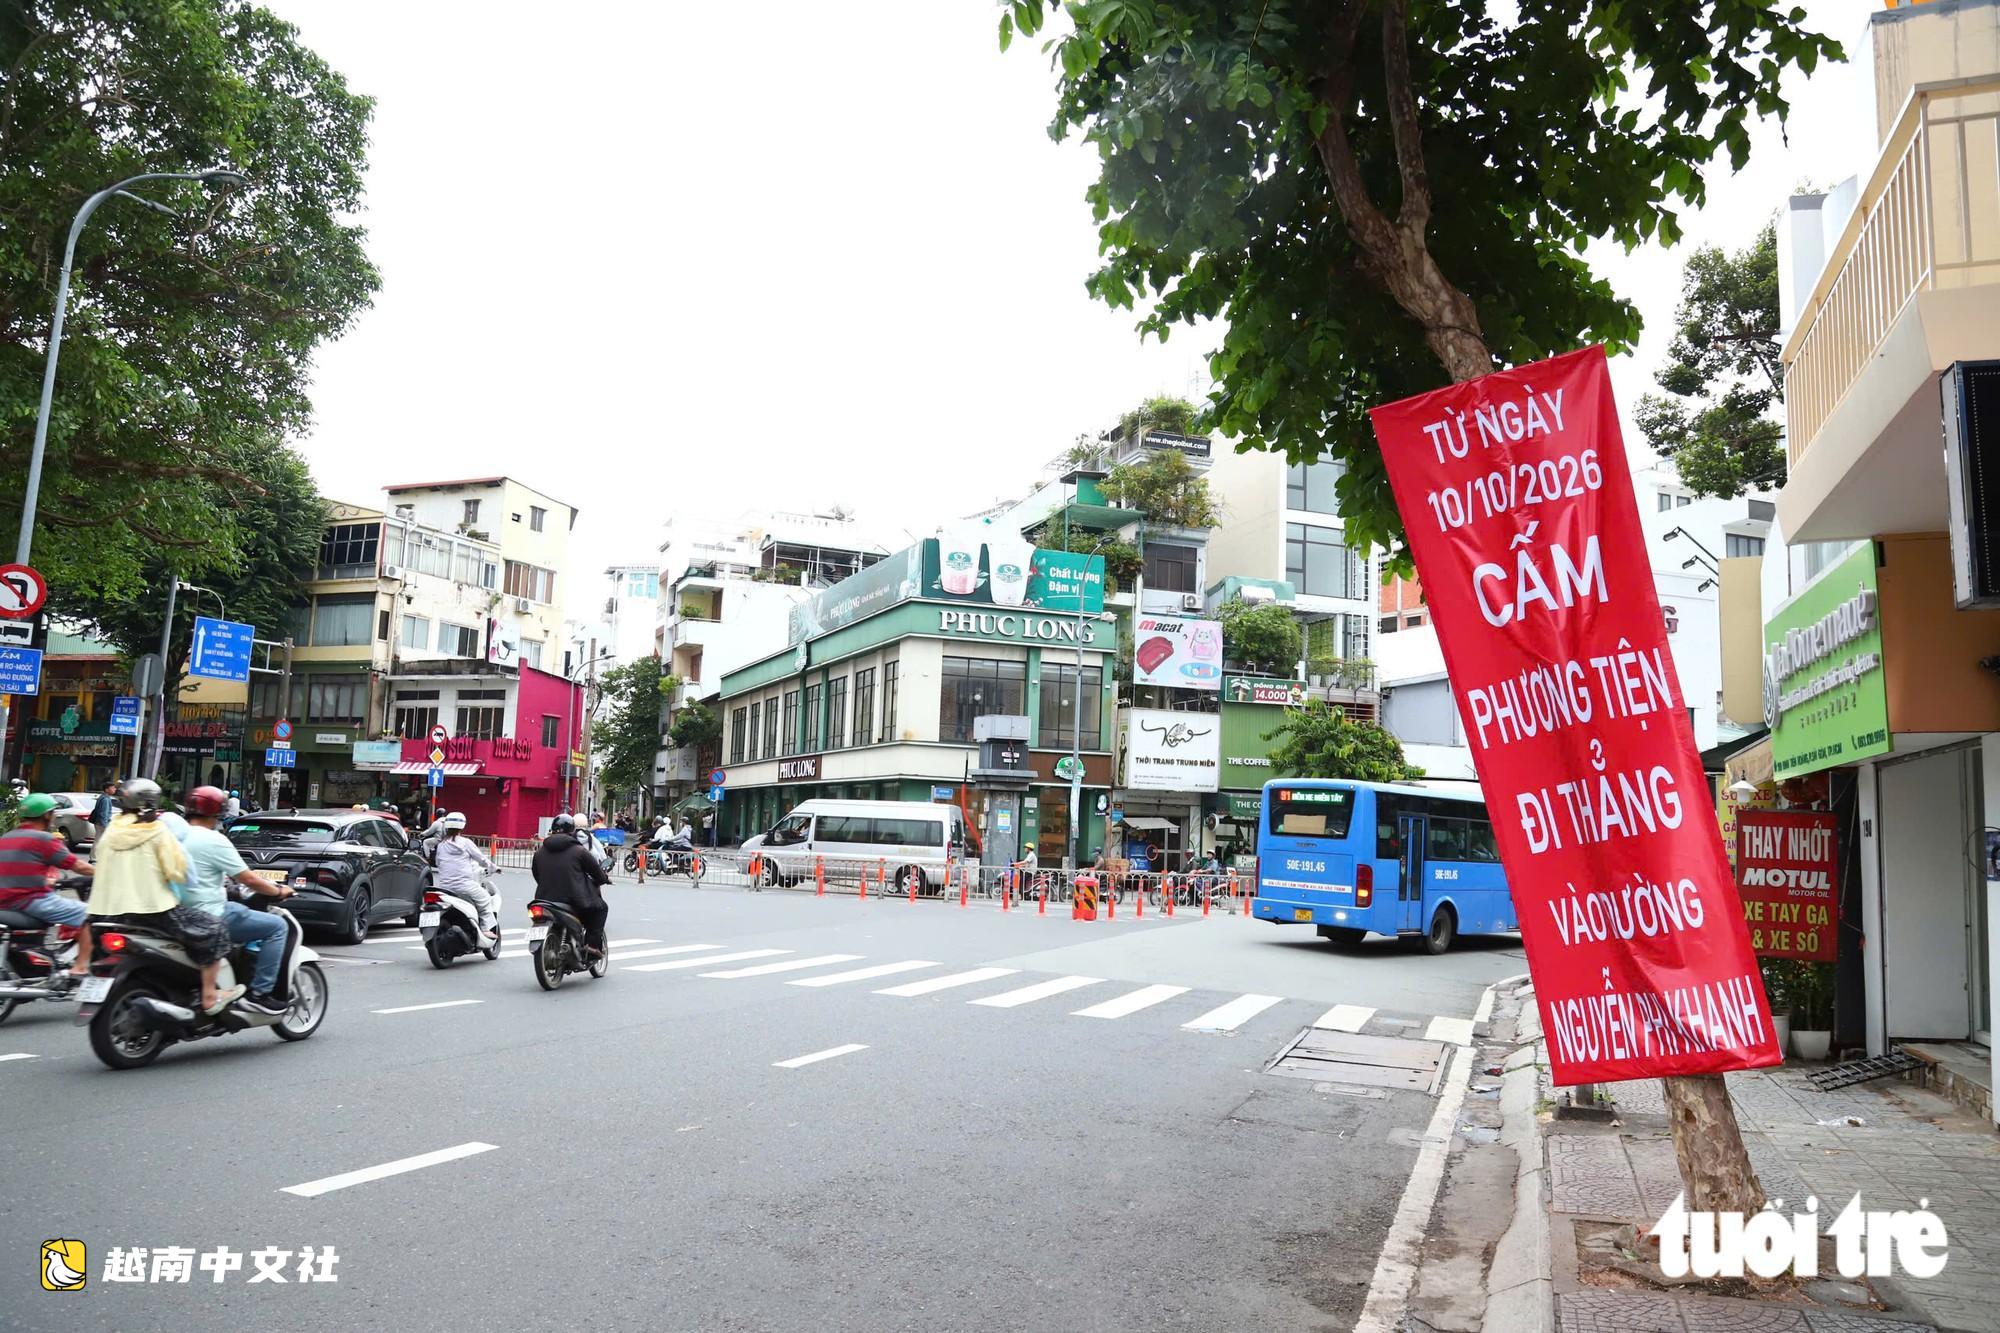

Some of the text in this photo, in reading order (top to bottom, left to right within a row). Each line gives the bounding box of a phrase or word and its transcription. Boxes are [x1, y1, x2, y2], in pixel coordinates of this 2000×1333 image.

[1423, 384, 1564, 465] TỪ NGÀY
[1428, 449, 1603, 532] 10/10/2026
[1049, 566, 1071, 579] Chất
[1473, 521, 1609, 628] CẤM
[939, 610, 1096, 643] PHUC LONG
[1138, 619, 1184, 634] macat
[1255, 689, 1287, 701] 14.000
[1467, 660, 1592, 750] PHƯƠNG
[1590, 637, 1674, 732] TIỆN
[797, 760, 816, 777] LONG
[1153, 757, 1174, 765] TRANG
[1227, 757, 1271, 766] THE COFFEE
[1516, 738, 1683, 855] ĐI THẲNG
[1743, 820, 1832, 863] THAY NHỚT
[1286, 859, 1326, 872] 50E-191.45
[1742, 867, 1831, 890] MOTUL
[1788, 889, 1830, 898] MOTOR OIL
[1744, 901, 1829, 926] XE TAY GA
[1752, 925, 1819, 953] & XE SỐ
